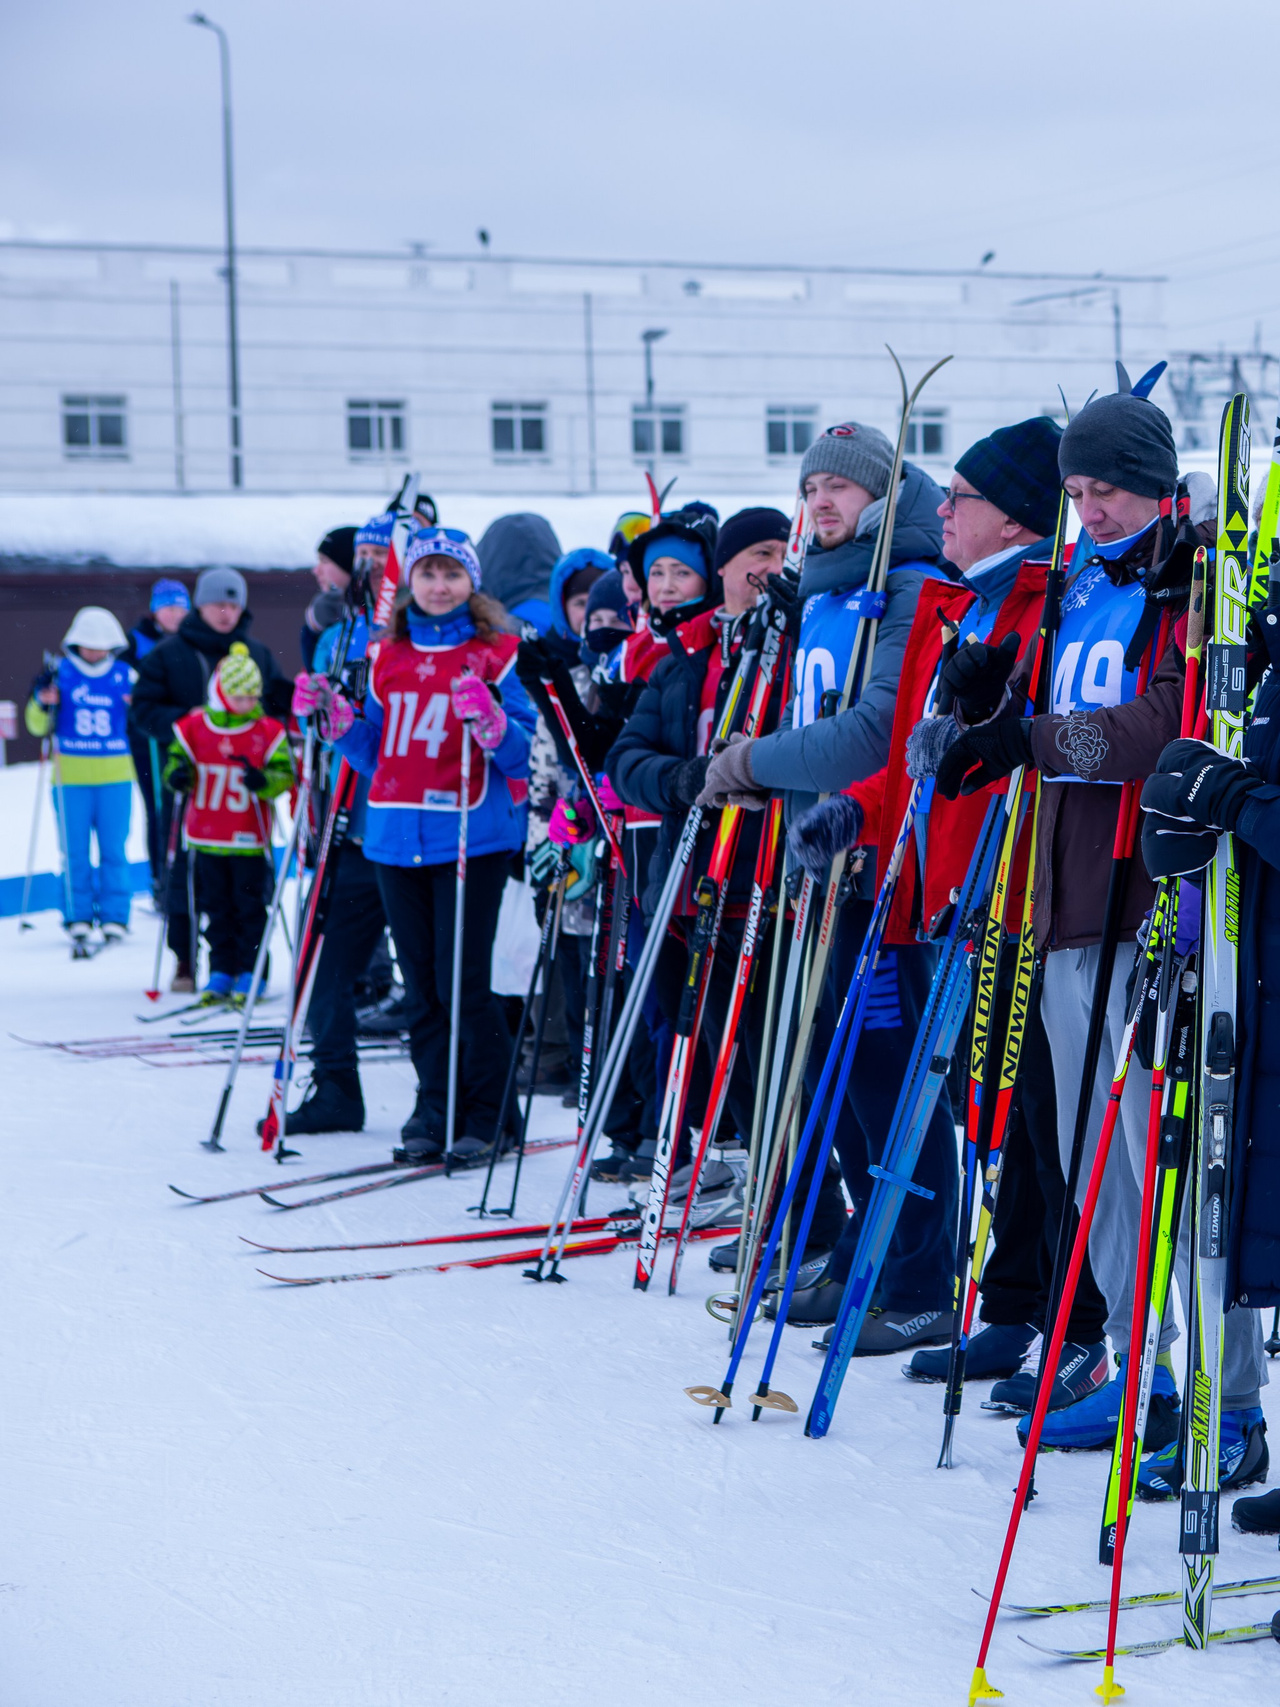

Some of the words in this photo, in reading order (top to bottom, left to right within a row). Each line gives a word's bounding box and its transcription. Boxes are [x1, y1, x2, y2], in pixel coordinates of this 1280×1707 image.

[373, 575, 398, 628] WAY
[1053, 640, 1125, 717] 49
[1219, 648, 1229, 708] SPINE
[75, 709, 111, 736] 88
[384, 691, 450, 759] 114
[195, 762, 251, 813] 175
[743, 881, 763, 957] ATOMIC
[796, 877, 810, 942] MARPETTI
[821, 881, 837, 946] MARPETTI
[1224, 867, 1241, 947] SKATING
[924, 958, 945, 1018] KARHU
[970, 917, 1001, 1080] SALOMON
[1003, 921, 1035, 1083] SALOMON
[577, 1052, 592, 1124] ACTIVE
[638, 1137, 672, 1278] ATOMIC
[1211, 1196, 1220, 1257] SALOMON
[823, 1305, 860, 1398] EXPLORER
[1058, 1354, 1084, 1379] VERONA
[1190, 1369, 1212, 1446] SKATING
[1200, 1493, 1210, 1552] SPINE
